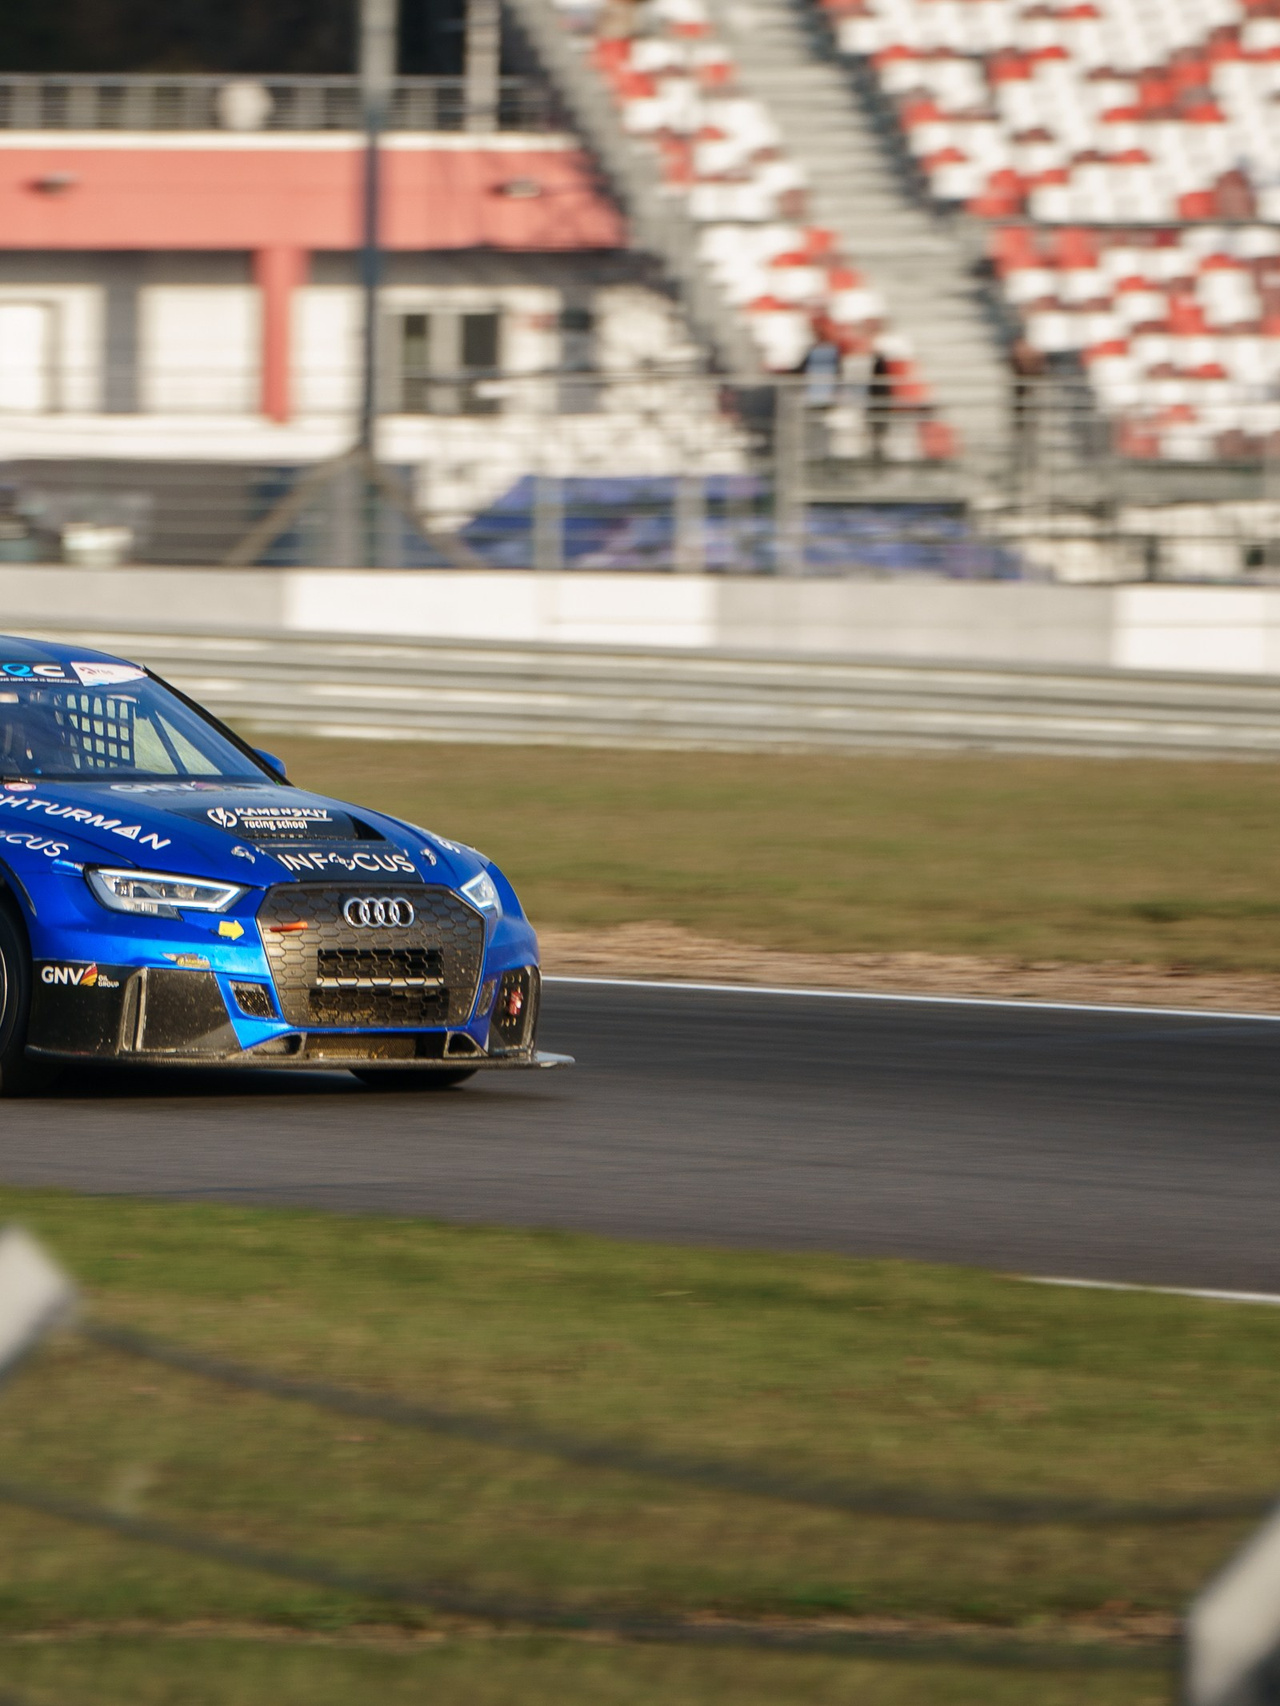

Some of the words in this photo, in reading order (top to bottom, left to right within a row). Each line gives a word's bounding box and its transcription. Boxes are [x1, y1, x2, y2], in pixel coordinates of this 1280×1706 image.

[234, 807, 327, 819] KAMENSKIY
[244, 820, 277, 831] racing
[276, 819, 308, 829] school
[41, 965, 85, 985] GNV
[98, 980, 120, 988] GROUP
